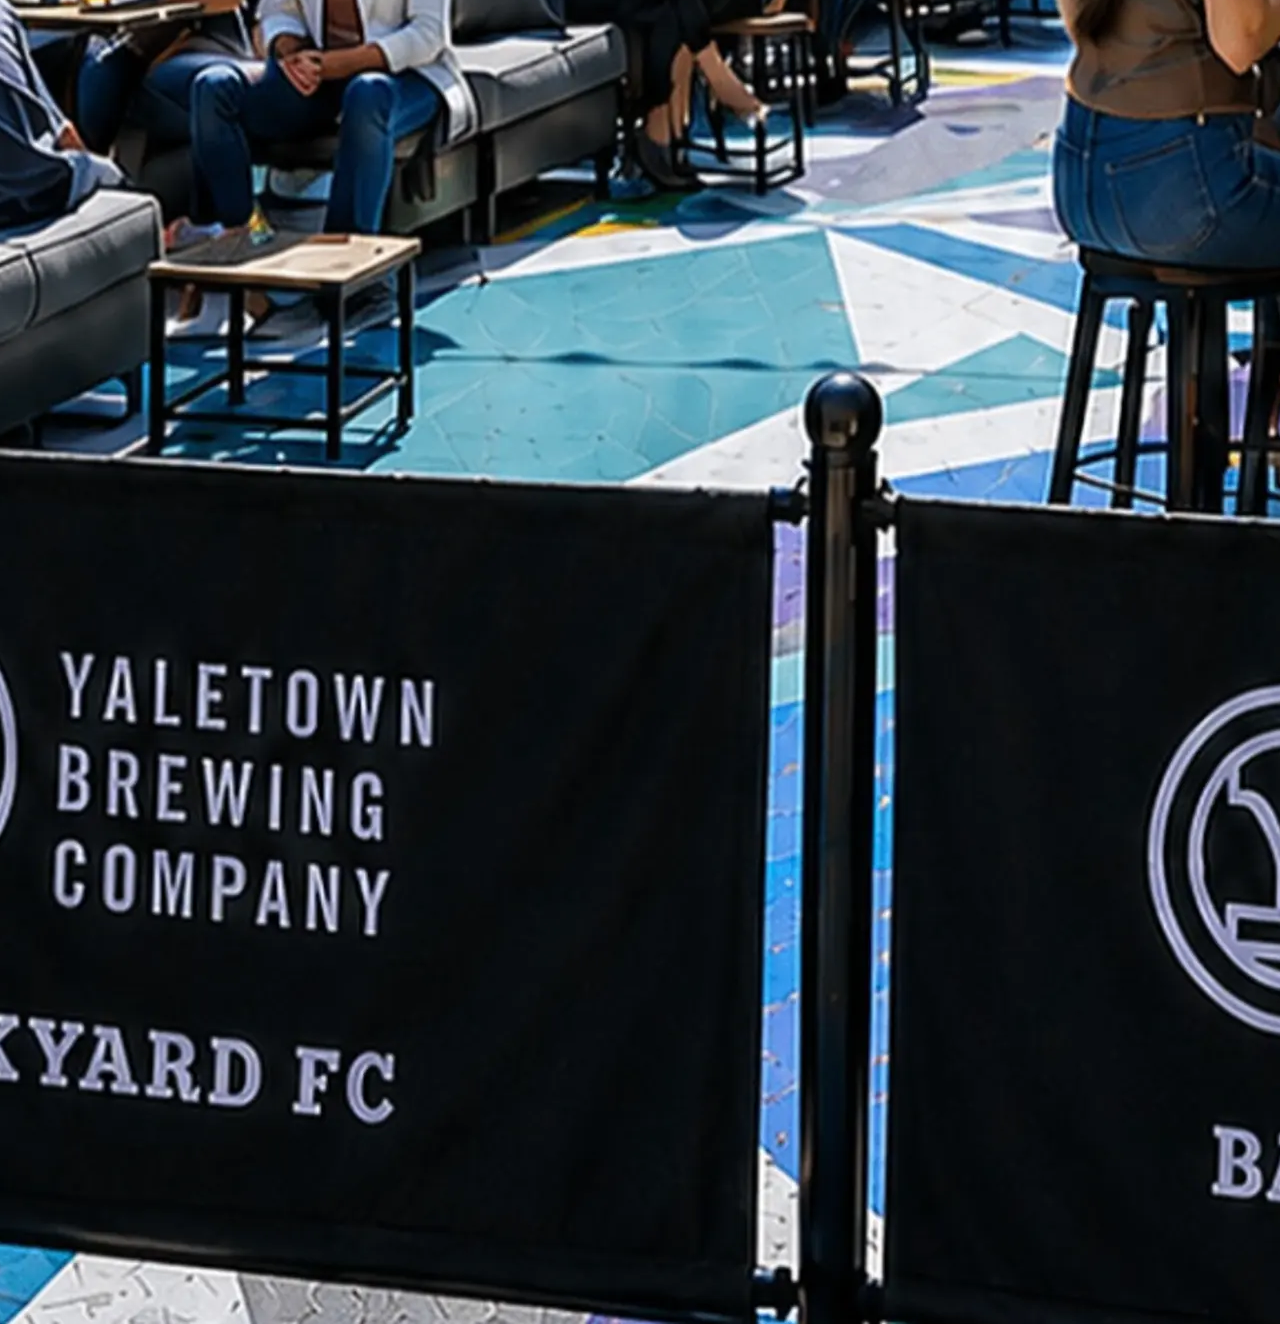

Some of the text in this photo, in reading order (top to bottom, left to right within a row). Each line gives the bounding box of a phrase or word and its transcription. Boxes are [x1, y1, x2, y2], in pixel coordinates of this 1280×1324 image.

[61, 652, 434, 747] YALETOWN
[57, 744, 384, 841] BREWING
[54, 839, 390, 936] COMPANY
[292, 1046, 395, 1123] FC
